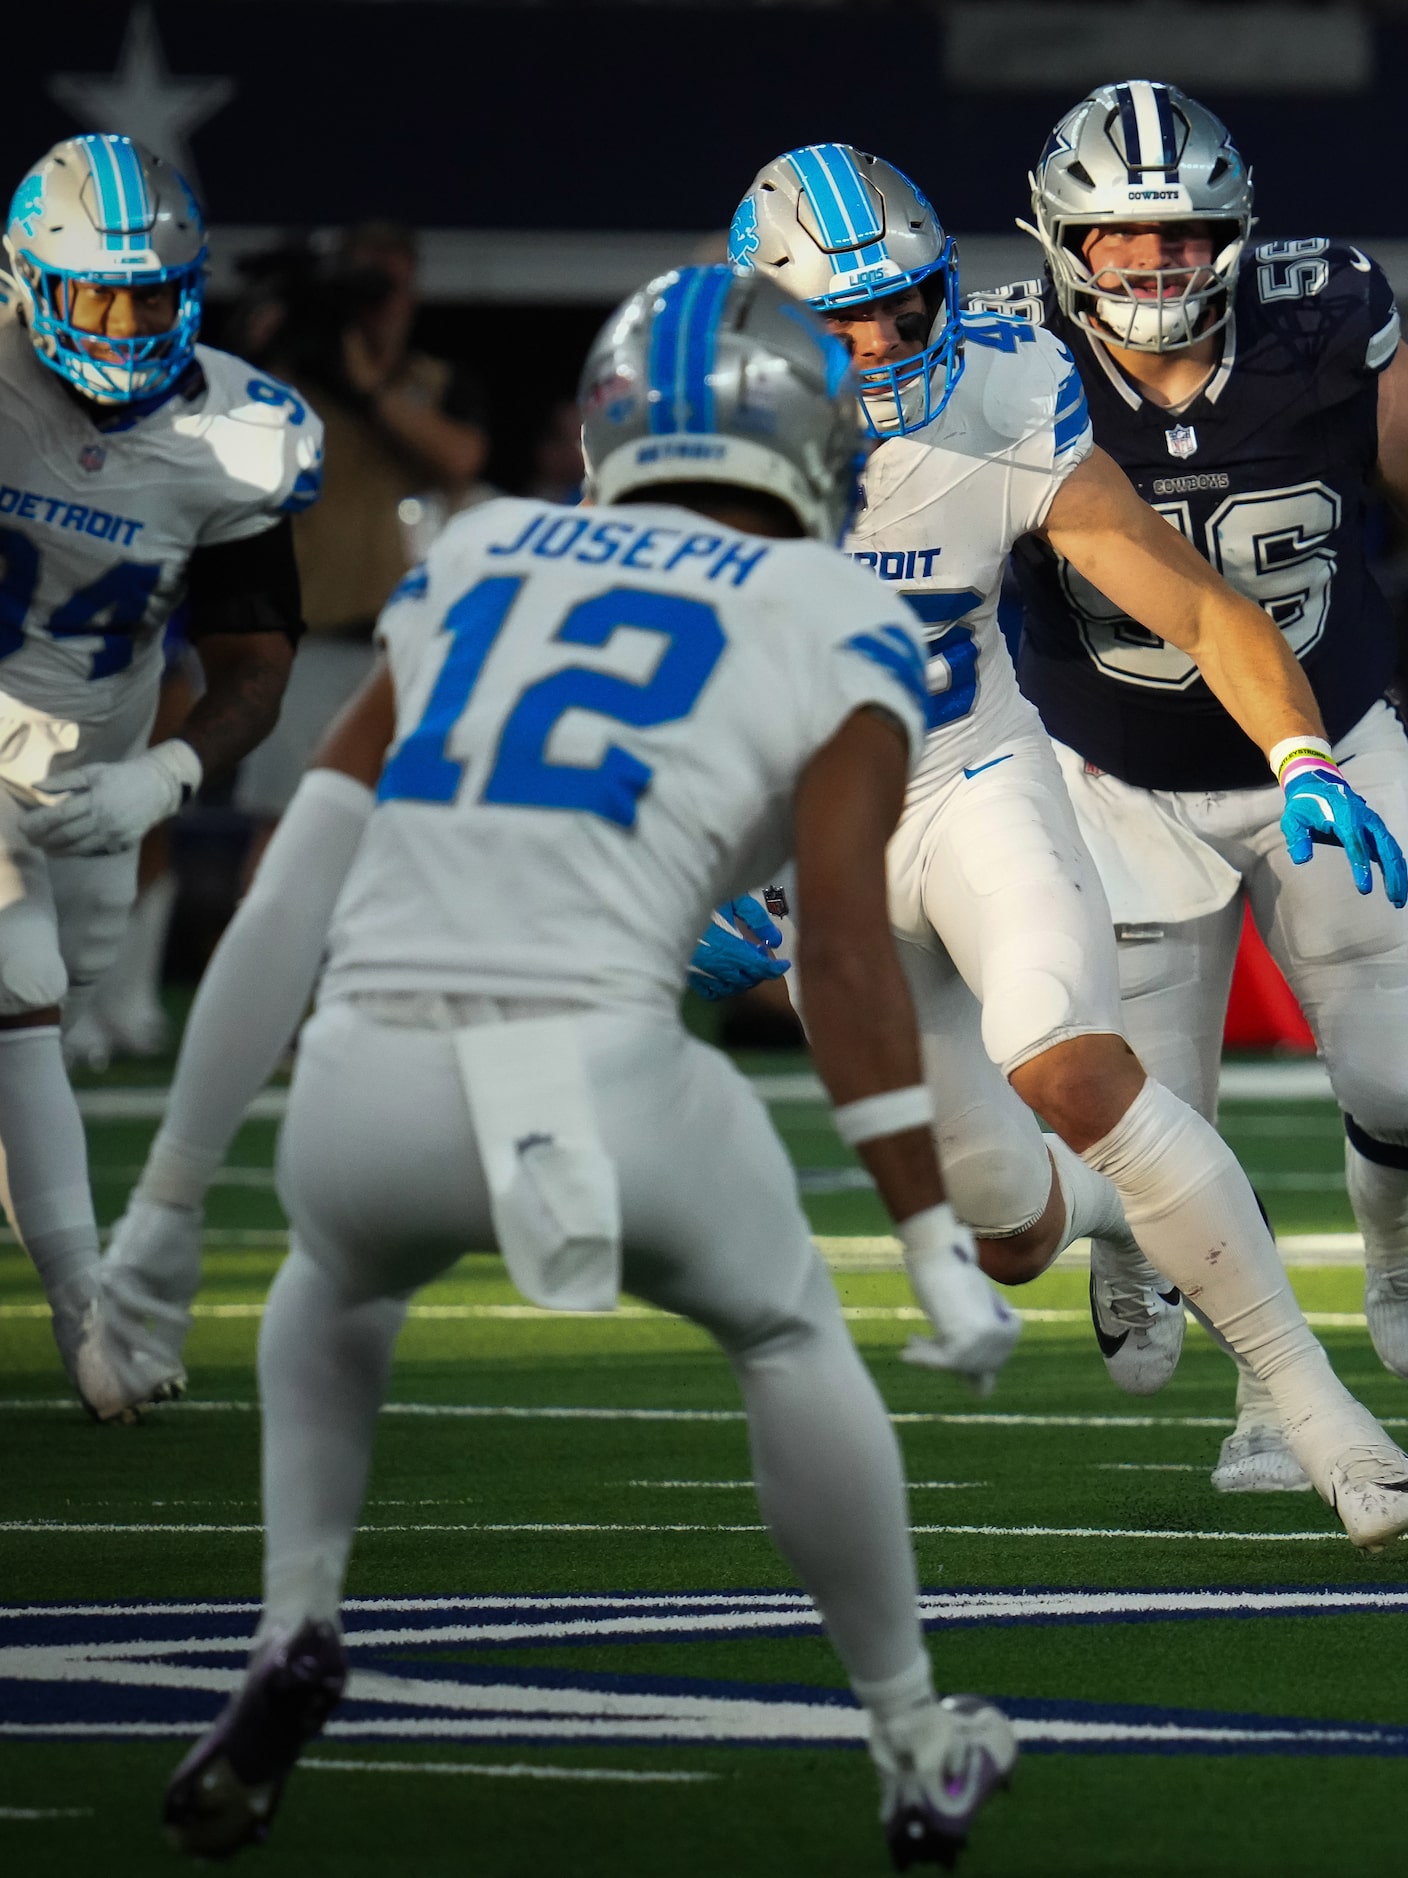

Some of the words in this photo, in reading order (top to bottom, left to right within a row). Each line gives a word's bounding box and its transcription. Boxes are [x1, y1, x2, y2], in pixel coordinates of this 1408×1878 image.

[1128, 190, 1179, 200] COWBOYS
[1256, 237, 1330, 304] 56
[0, 483, 144, 547] DETROIT
[1153, 473, 1230, 495] COWBOYS
[486, 513, 770, 588] JOSEPH
[846, 547, 942, 581] ROIT
[374, 572, 729, 832] 12
